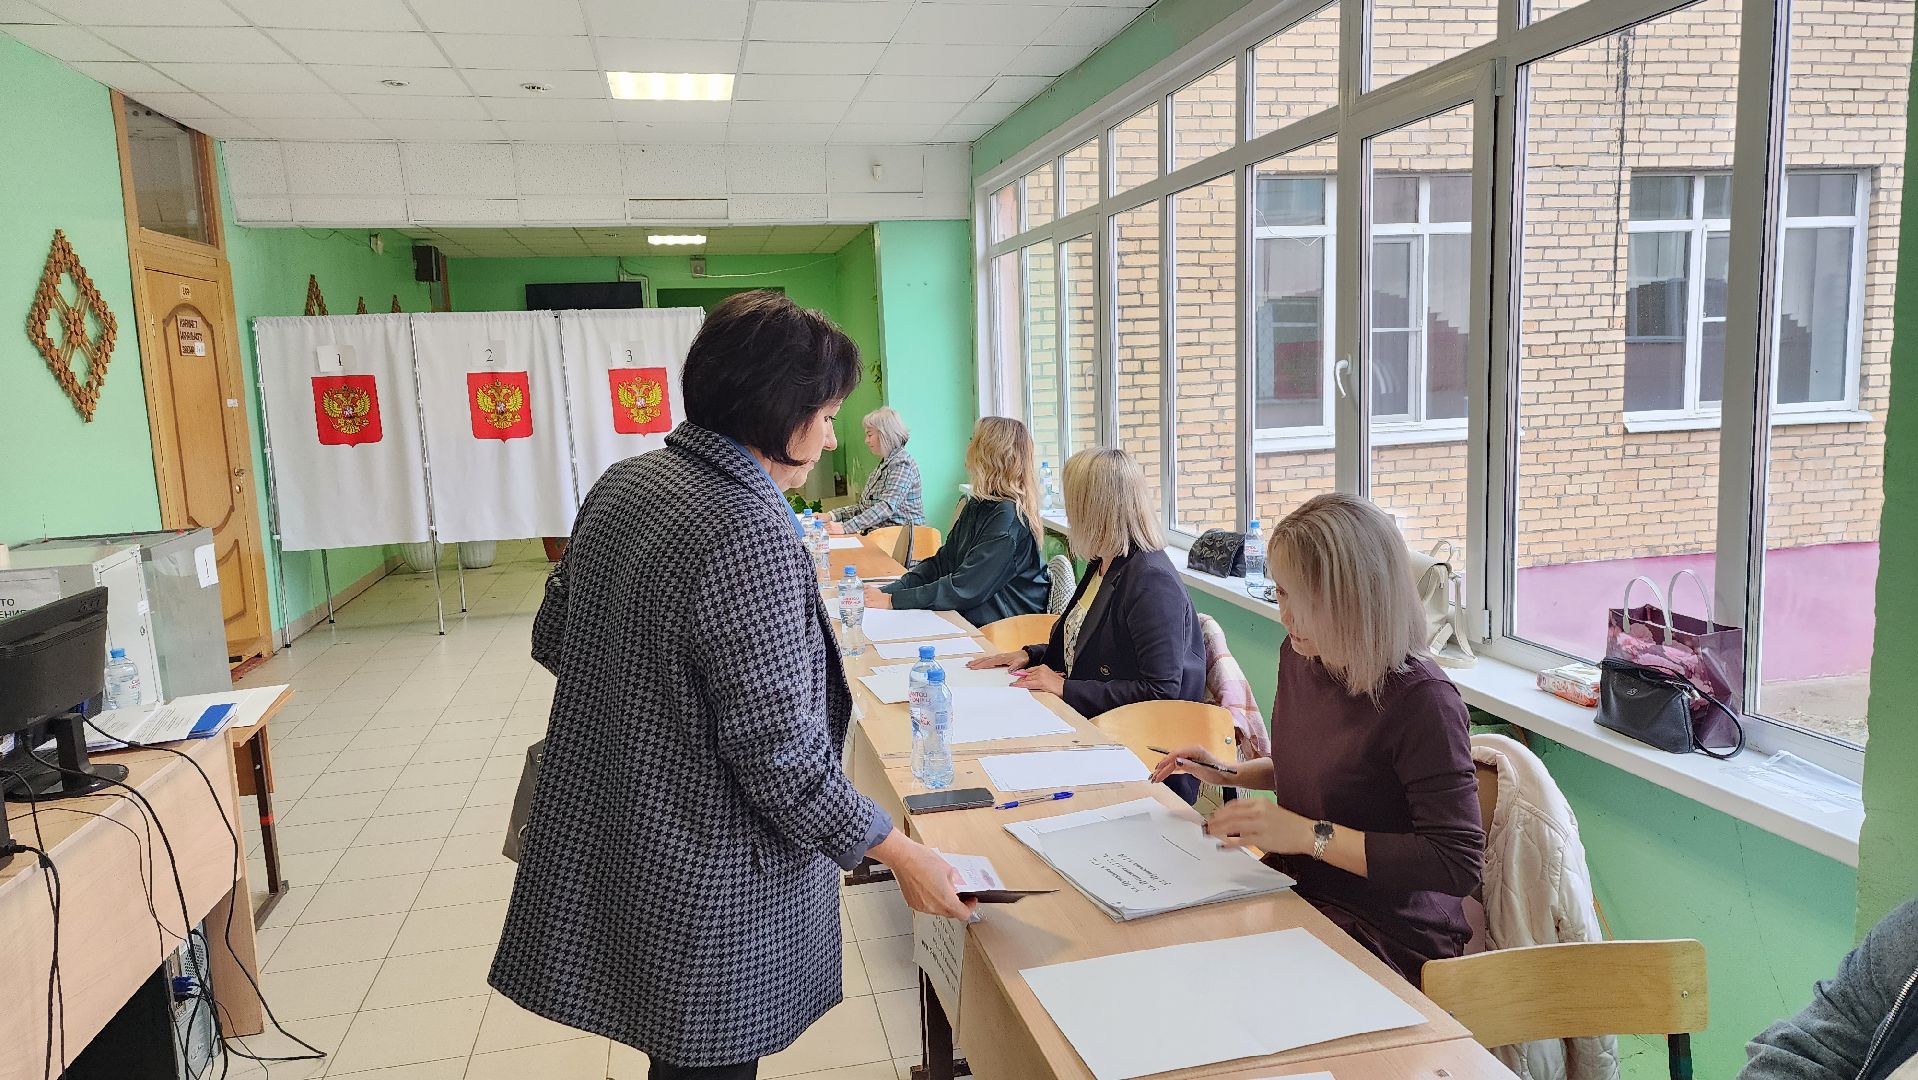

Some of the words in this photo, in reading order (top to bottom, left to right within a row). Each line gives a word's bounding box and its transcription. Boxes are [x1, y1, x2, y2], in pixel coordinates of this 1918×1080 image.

[337, 353, 344, 366] 1
[484, 348, 494, 361] 2
[625, 349, 633, 362] 3
